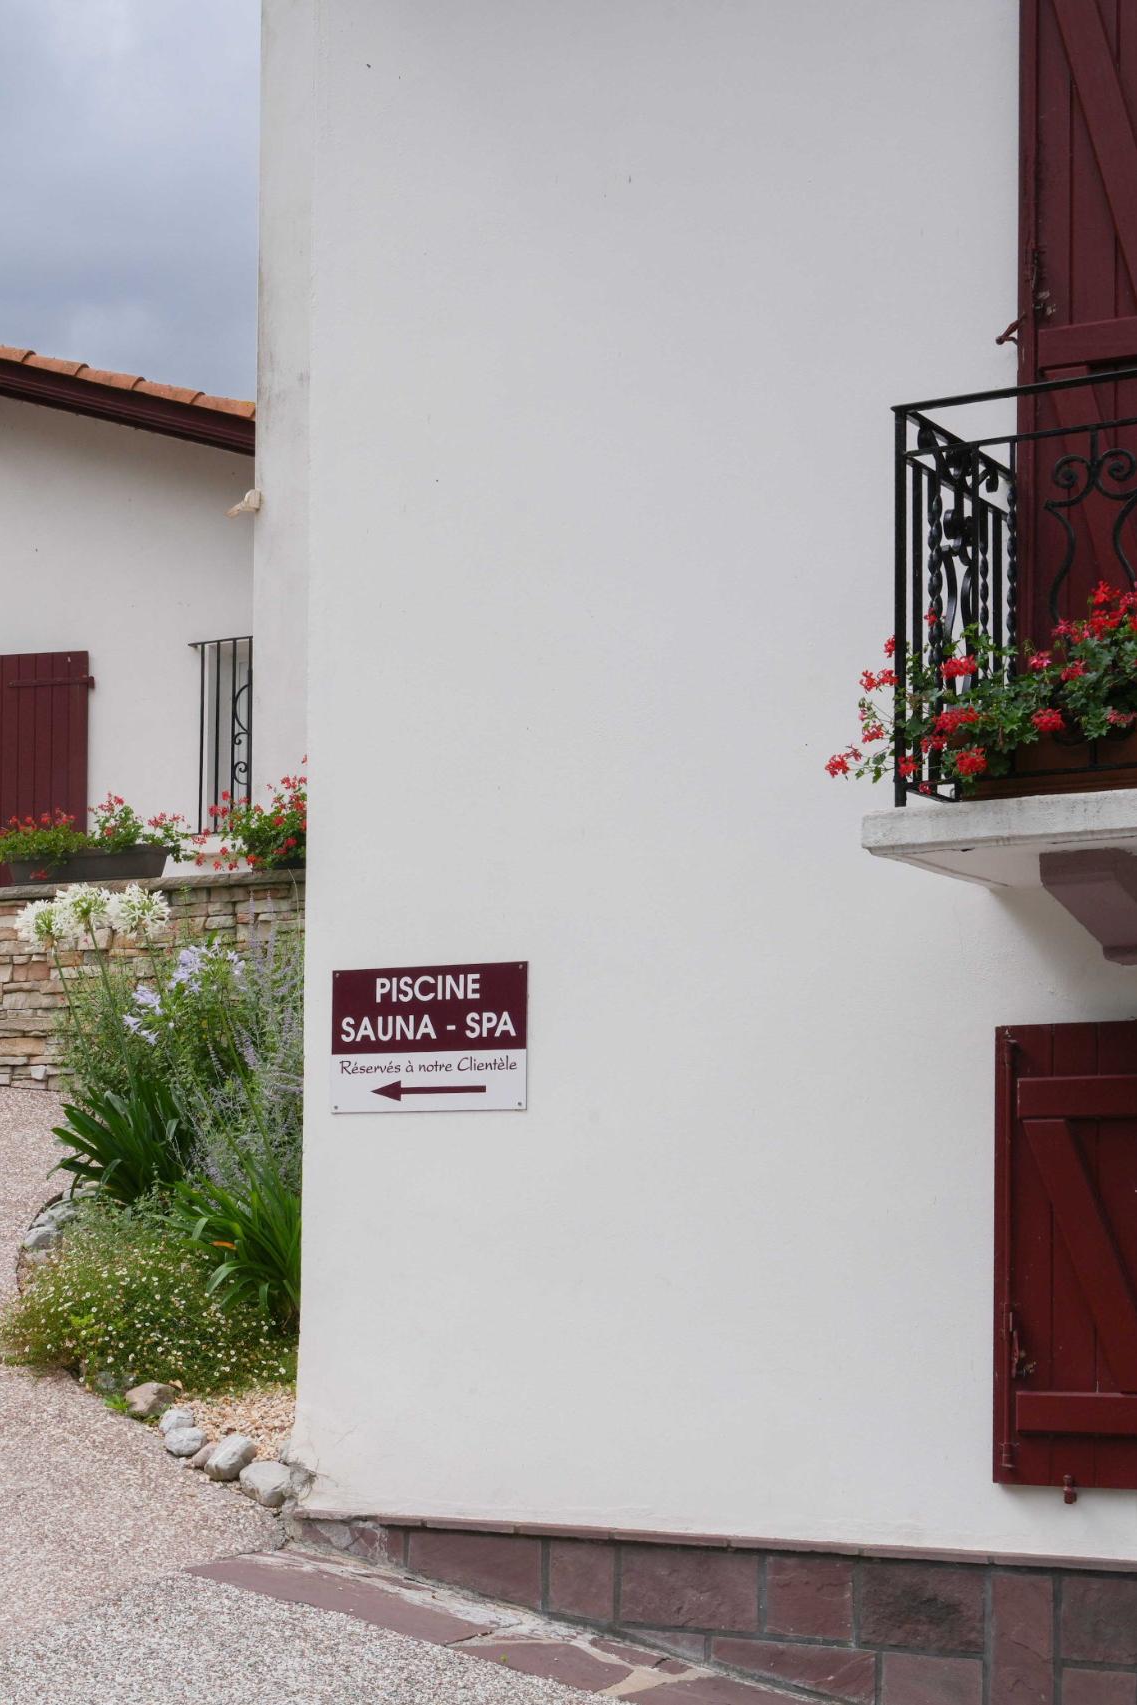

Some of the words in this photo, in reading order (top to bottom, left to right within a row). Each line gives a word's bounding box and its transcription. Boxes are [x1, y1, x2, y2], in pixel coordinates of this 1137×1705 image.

[376, 974, 480, 1003] PISCINE
[341, 1014, 437, 1042] SAUNA
[465, 1011, 517, 1039] SPA
[339, 1060, 401, 1075] Réservés
[405, 1060, 414, 1073] à
[418, 1060, 453, 1073] notre
[457, 1055, 518, 1072] Clientèle
